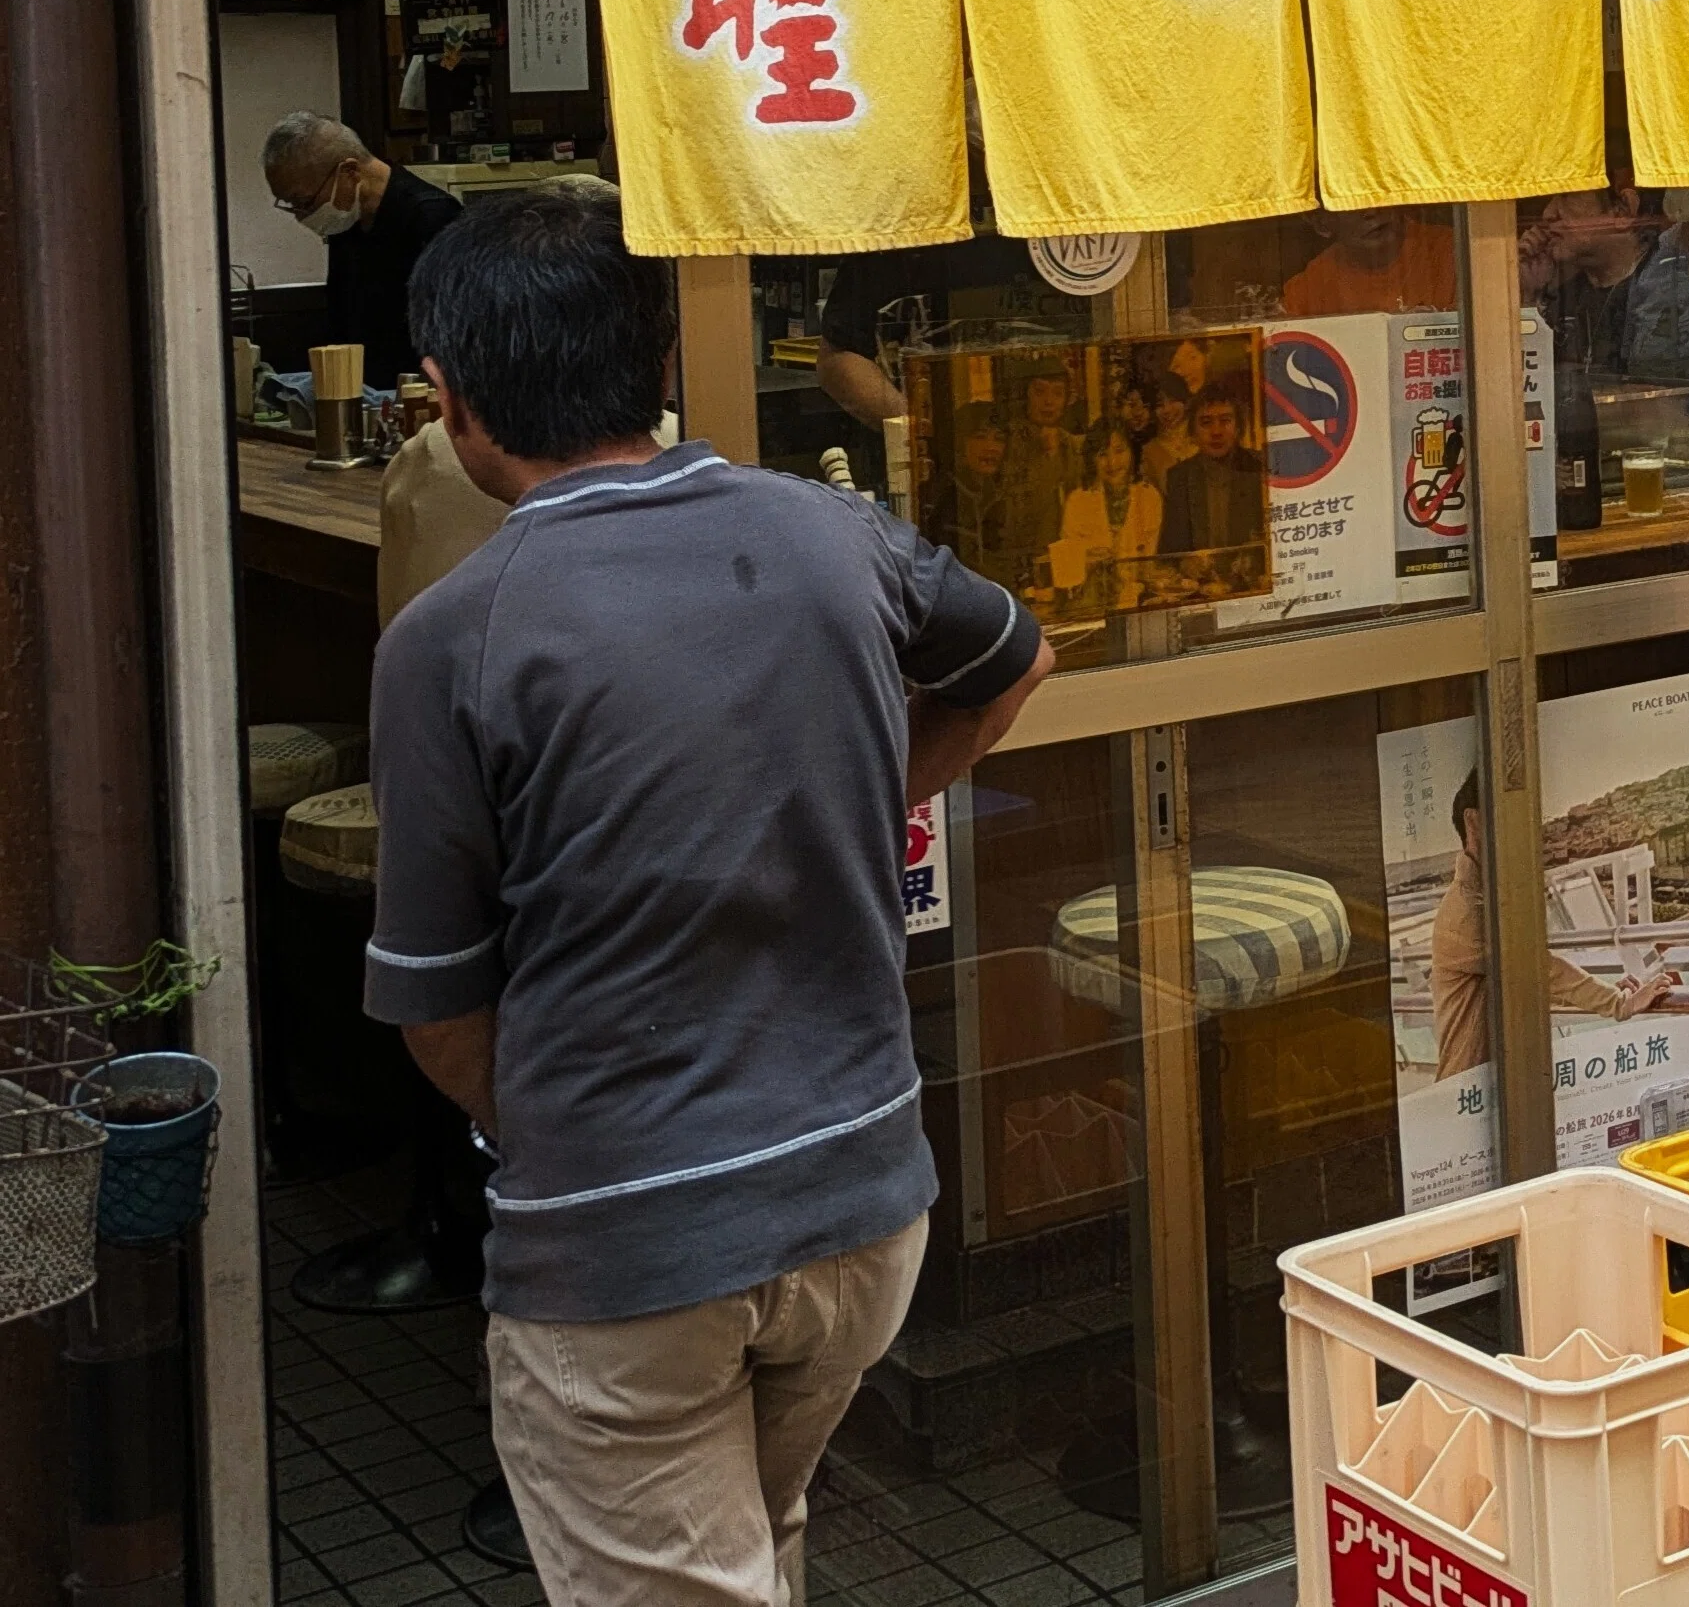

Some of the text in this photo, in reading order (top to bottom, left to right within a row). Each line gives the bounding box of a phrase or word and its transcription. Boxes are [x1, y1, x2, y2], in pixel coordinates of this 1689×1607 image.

[1289, 546, 1319, 557] Smoking
[1632, 697, 1663, 713] PEACE
[1457, 1033, 1671, 1115] 地 周の船旅
